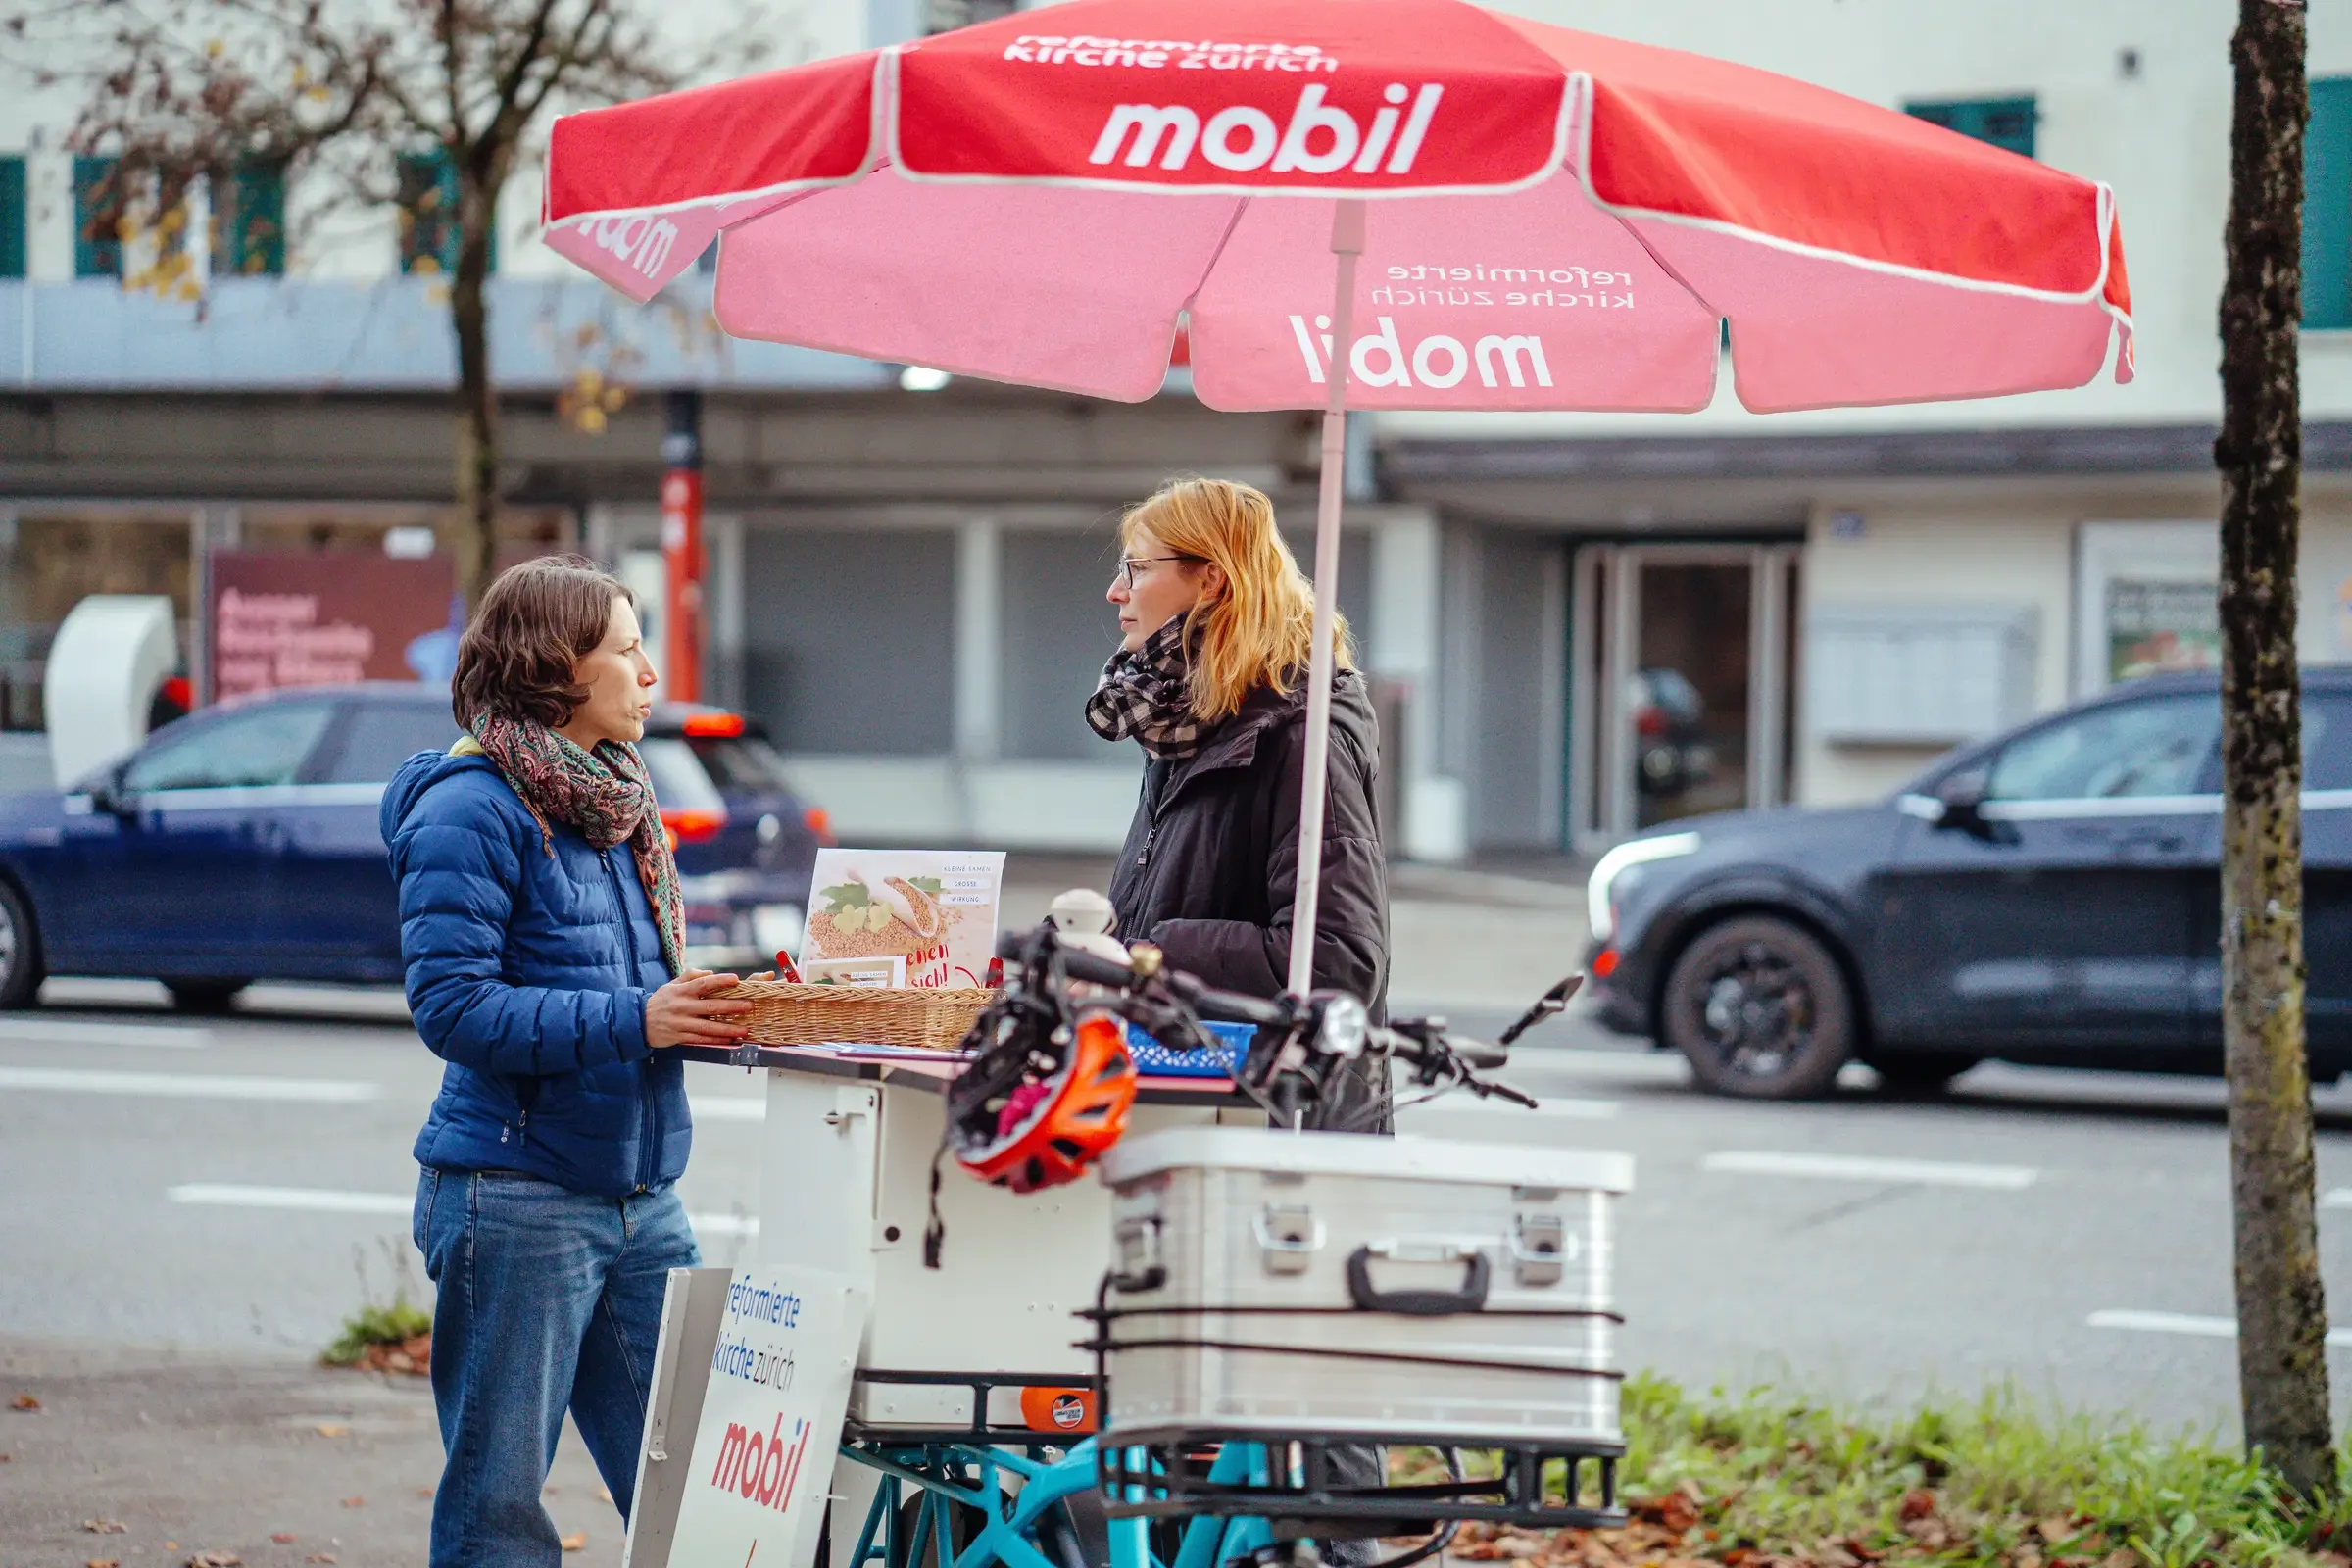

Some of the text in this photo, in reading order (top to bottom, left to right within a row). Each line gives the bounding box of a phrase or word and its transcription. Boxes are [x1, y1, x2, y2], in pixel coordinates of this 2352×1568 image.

[1004, 45, 1169, 69] kirche
[1016, 35, 1323, 57] reformierte
[1088, 82, 1445, 174] mobil
[910, 962, 949, 988] sich!
[725, 1274, 801, 1329] reformierte
[712, 1330, 795, 1393] kirche zürich
[711, 1411, 811, 1514] mobil
